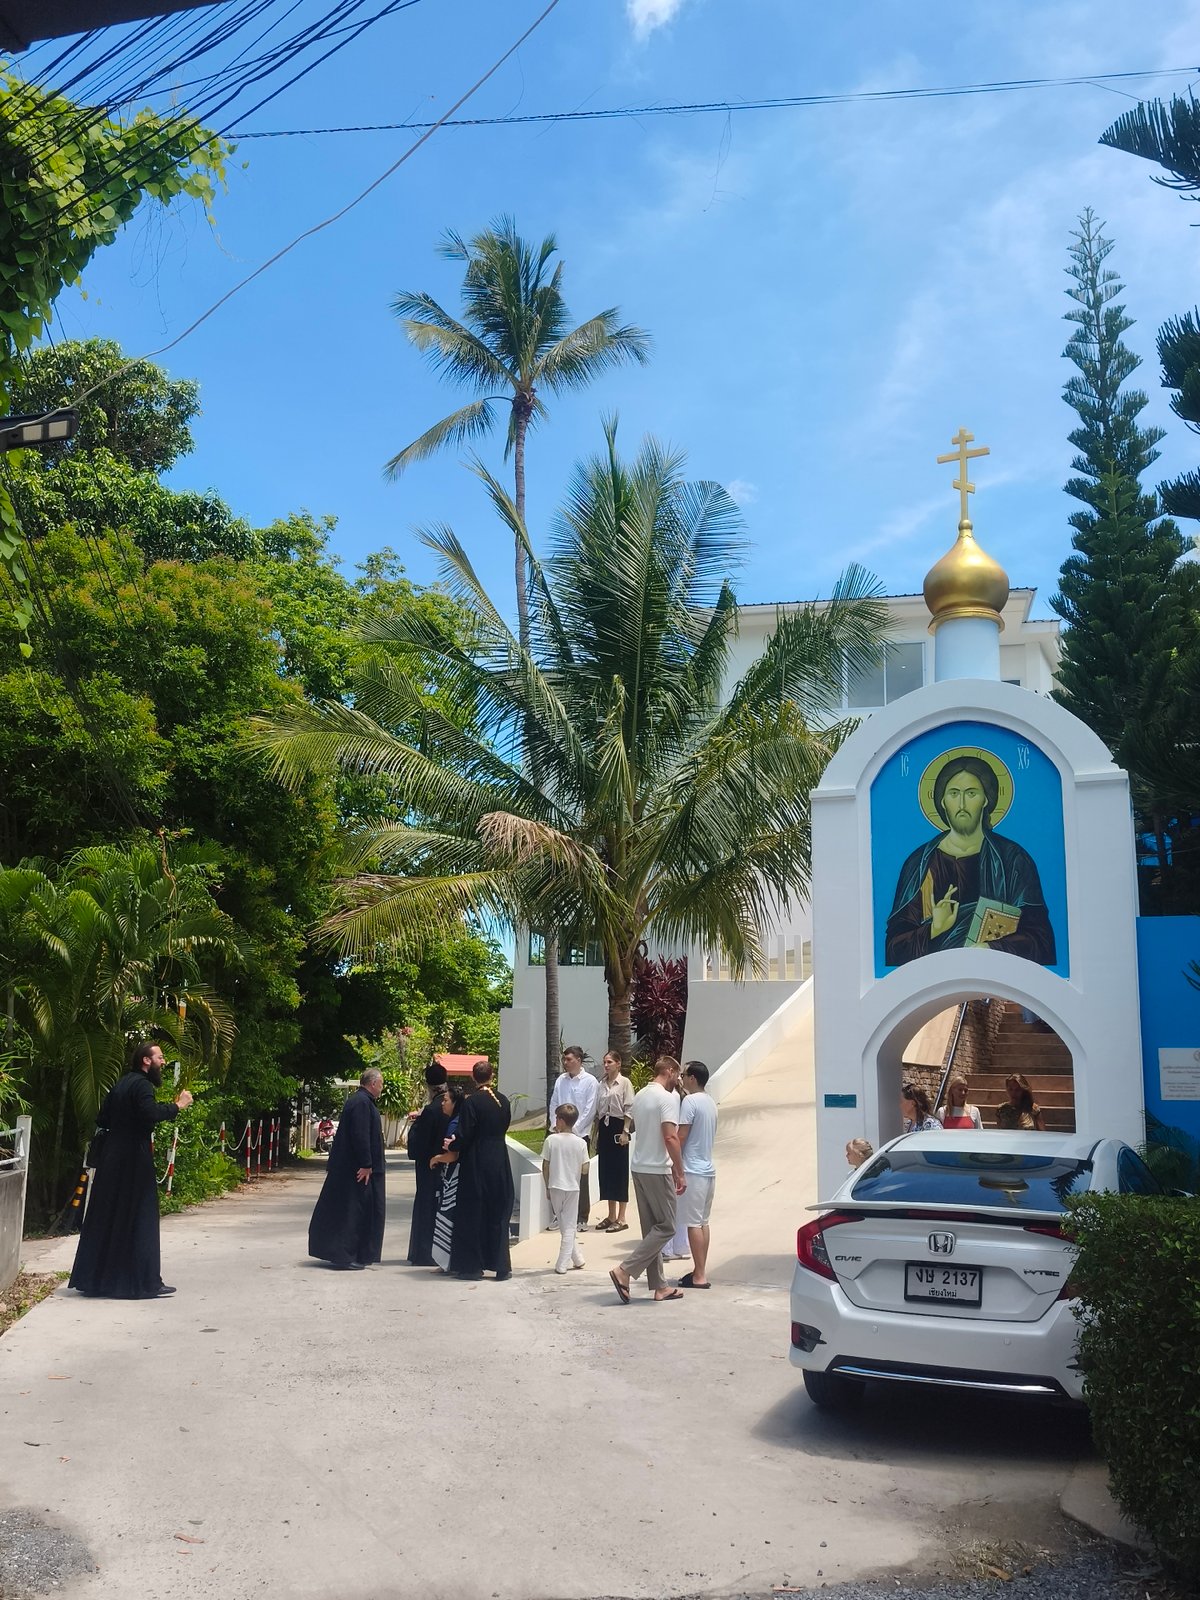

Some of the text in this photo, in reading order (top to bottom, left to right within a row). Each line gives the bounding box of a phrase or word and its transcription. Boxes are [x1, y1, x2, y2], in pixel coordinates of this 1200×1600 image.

[942, 1270, 978, 1287] 2137
[928, 1287, 957, 1298] เชียงใหม่
